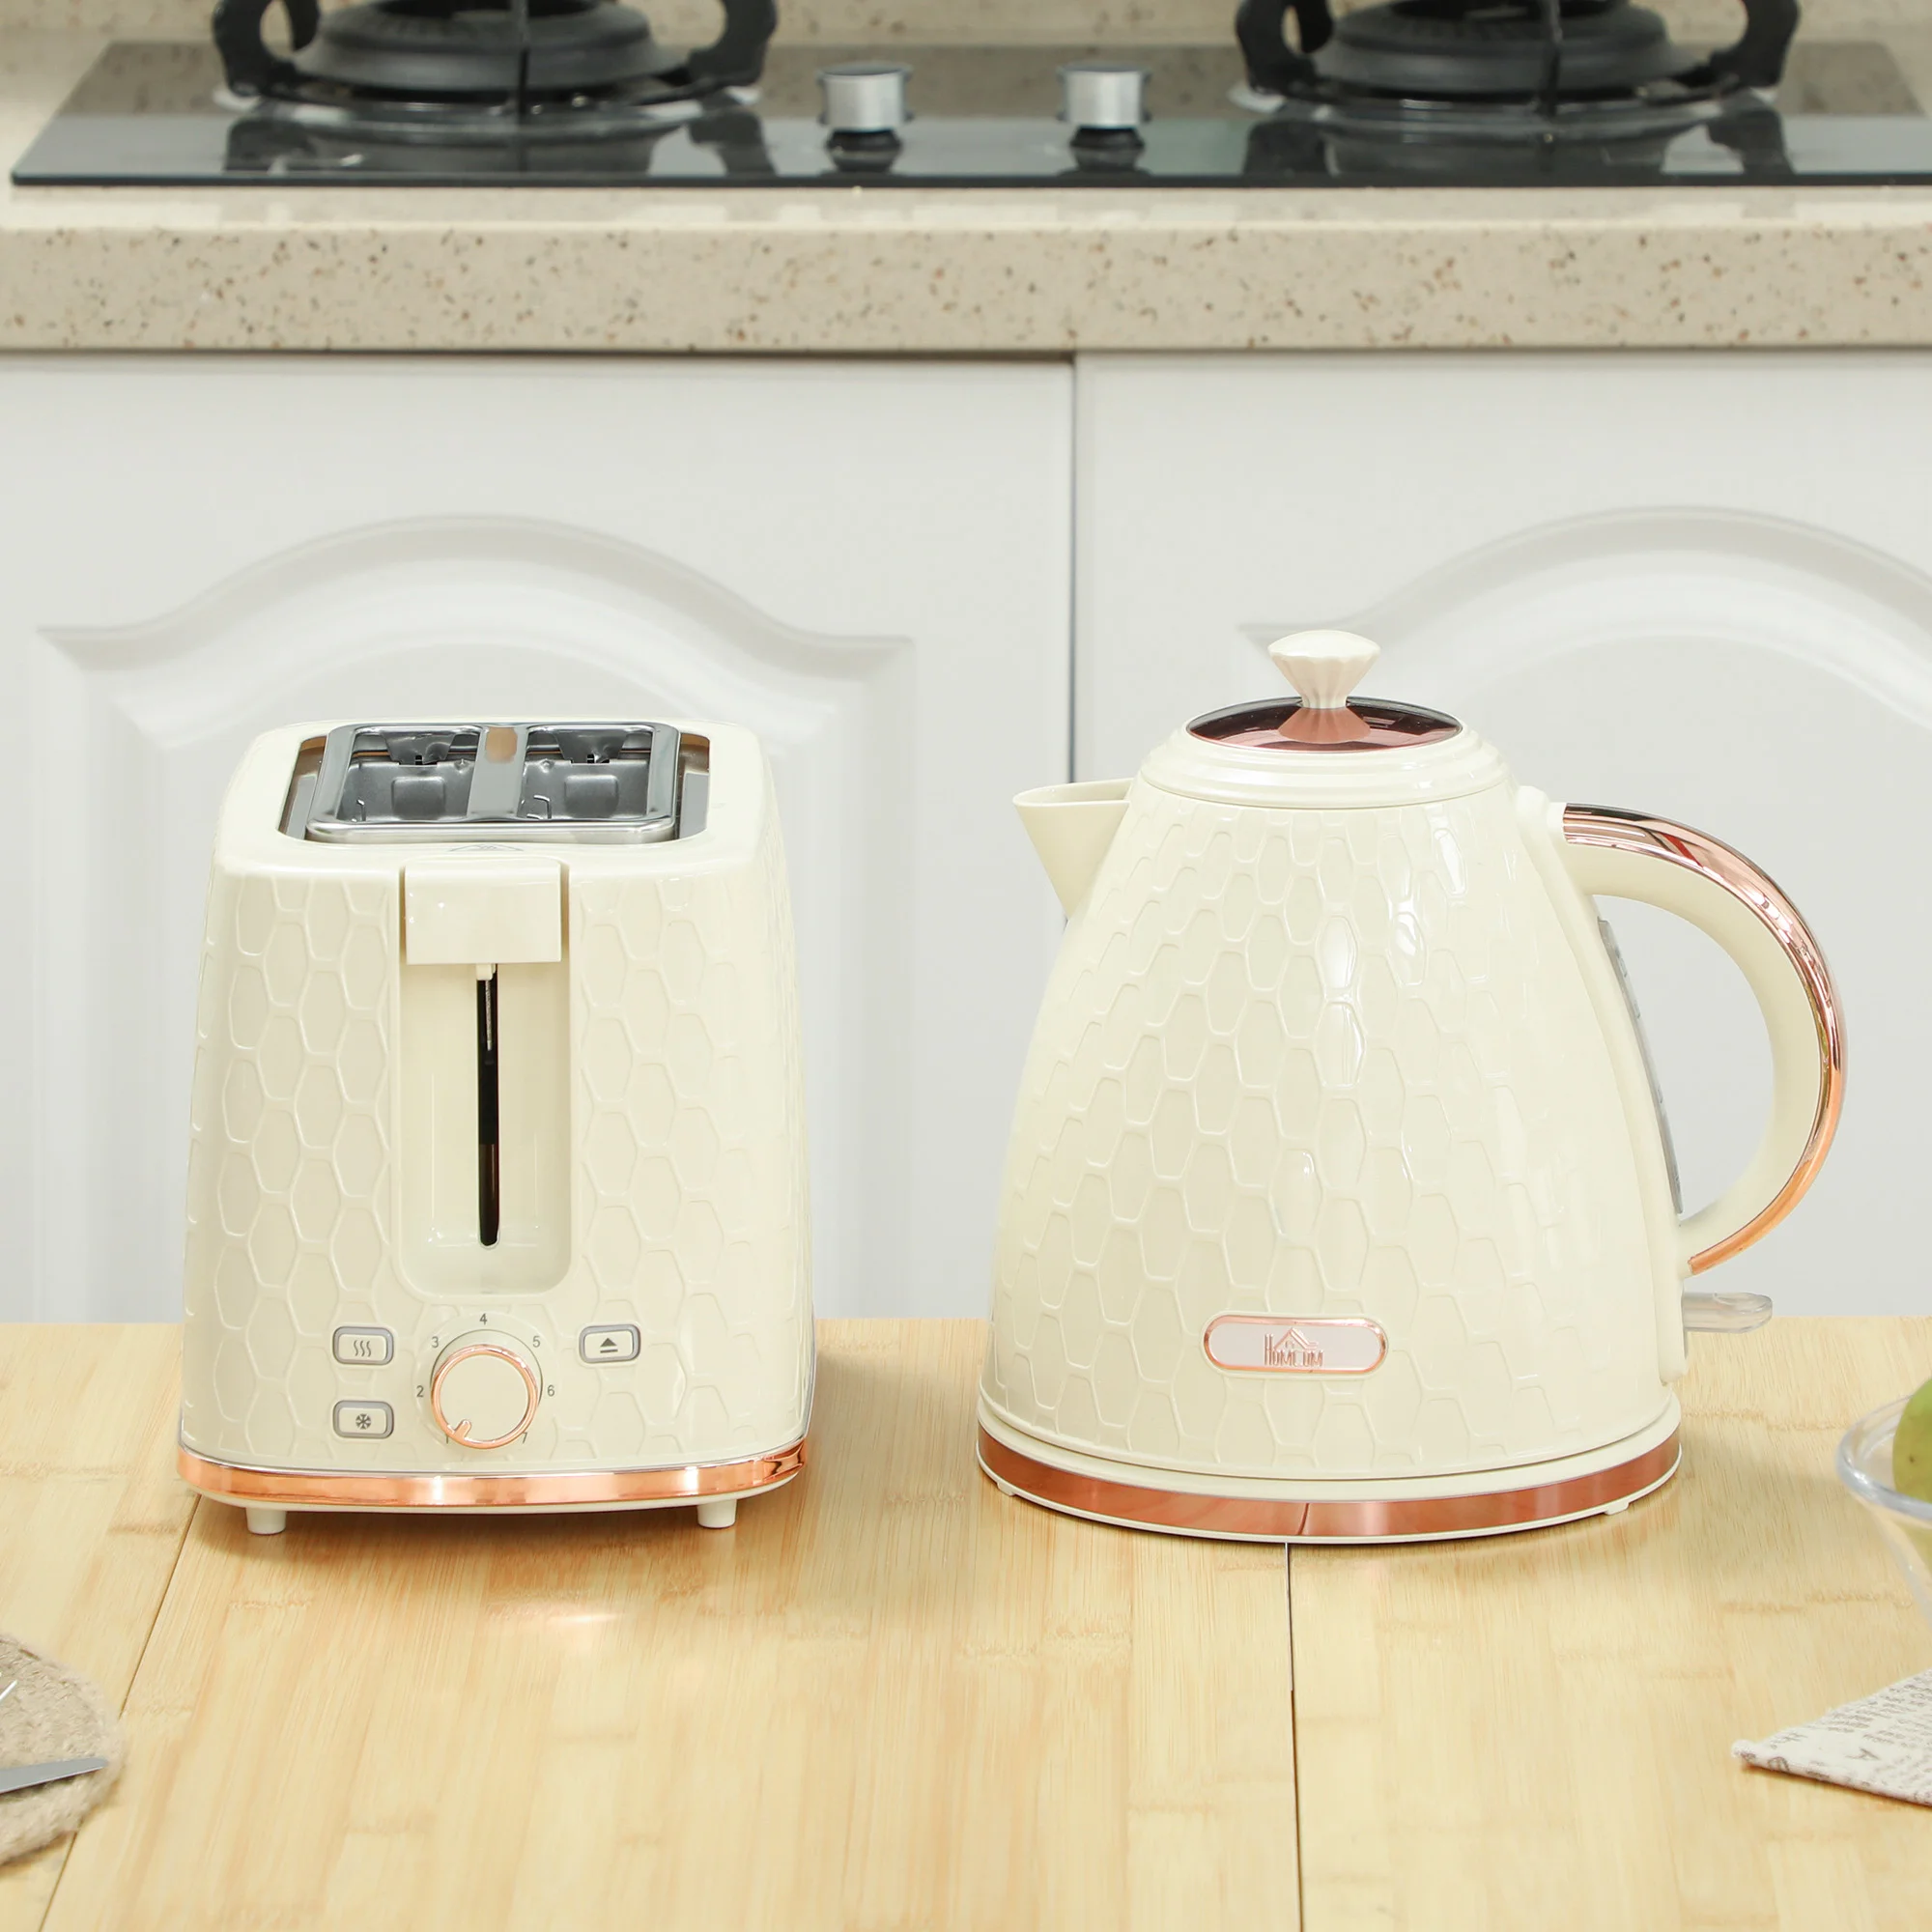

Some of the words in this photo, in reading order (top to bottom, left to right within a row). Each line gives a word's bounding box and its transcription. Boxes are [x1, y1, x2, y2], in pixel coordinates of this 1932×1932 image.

[479, 1313, 488, 1324] 4
[431, 1336, 440, 1348] 3
[532, 1336, 541, 1348] 5
[416, 1384, 425, 1398] 2
[547, 1383, 555, 1397] 6
[521, 1432, 528, 1444] 7
